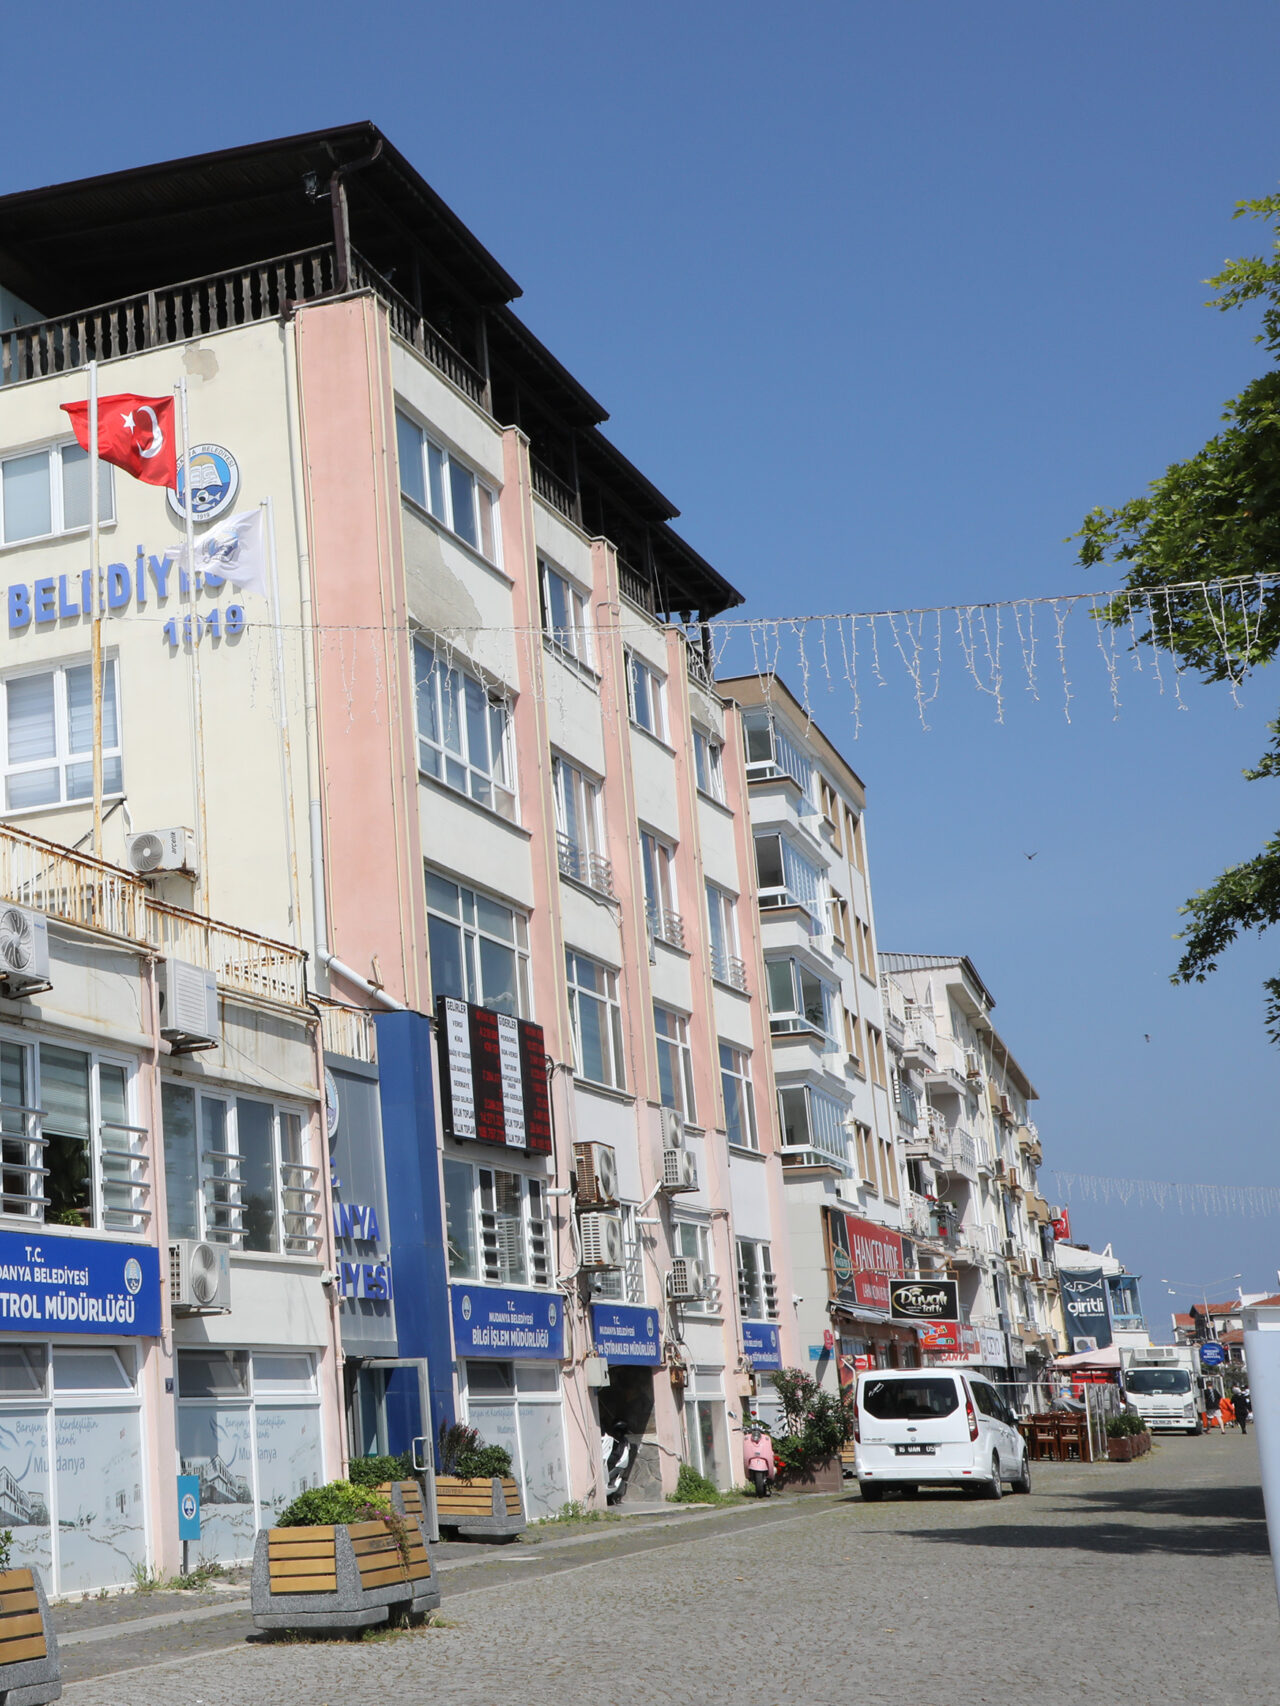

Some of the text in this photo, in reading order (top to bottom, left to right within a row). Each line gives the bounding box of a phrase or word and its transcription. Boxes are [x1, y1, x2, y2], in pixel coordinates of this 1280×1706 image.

[8, 544, 228, 630] BELEDİY
[333, 1203, 381, 1242] ANYA
[25, 1246, 45, 1263] T.C.
[33, 1265, 89, 1286] BELEDİYESİ
[336, 1249, 393, 1300] İYESİ
[45, 1291, 136, 1324] MÜDÜRLÜĞÜ
[1067, 1297, 1105, 1317] giritli
[472, 1325, 549, 1348] BİLGİ İŞLEM MÜDÜRLÜĞÜ
